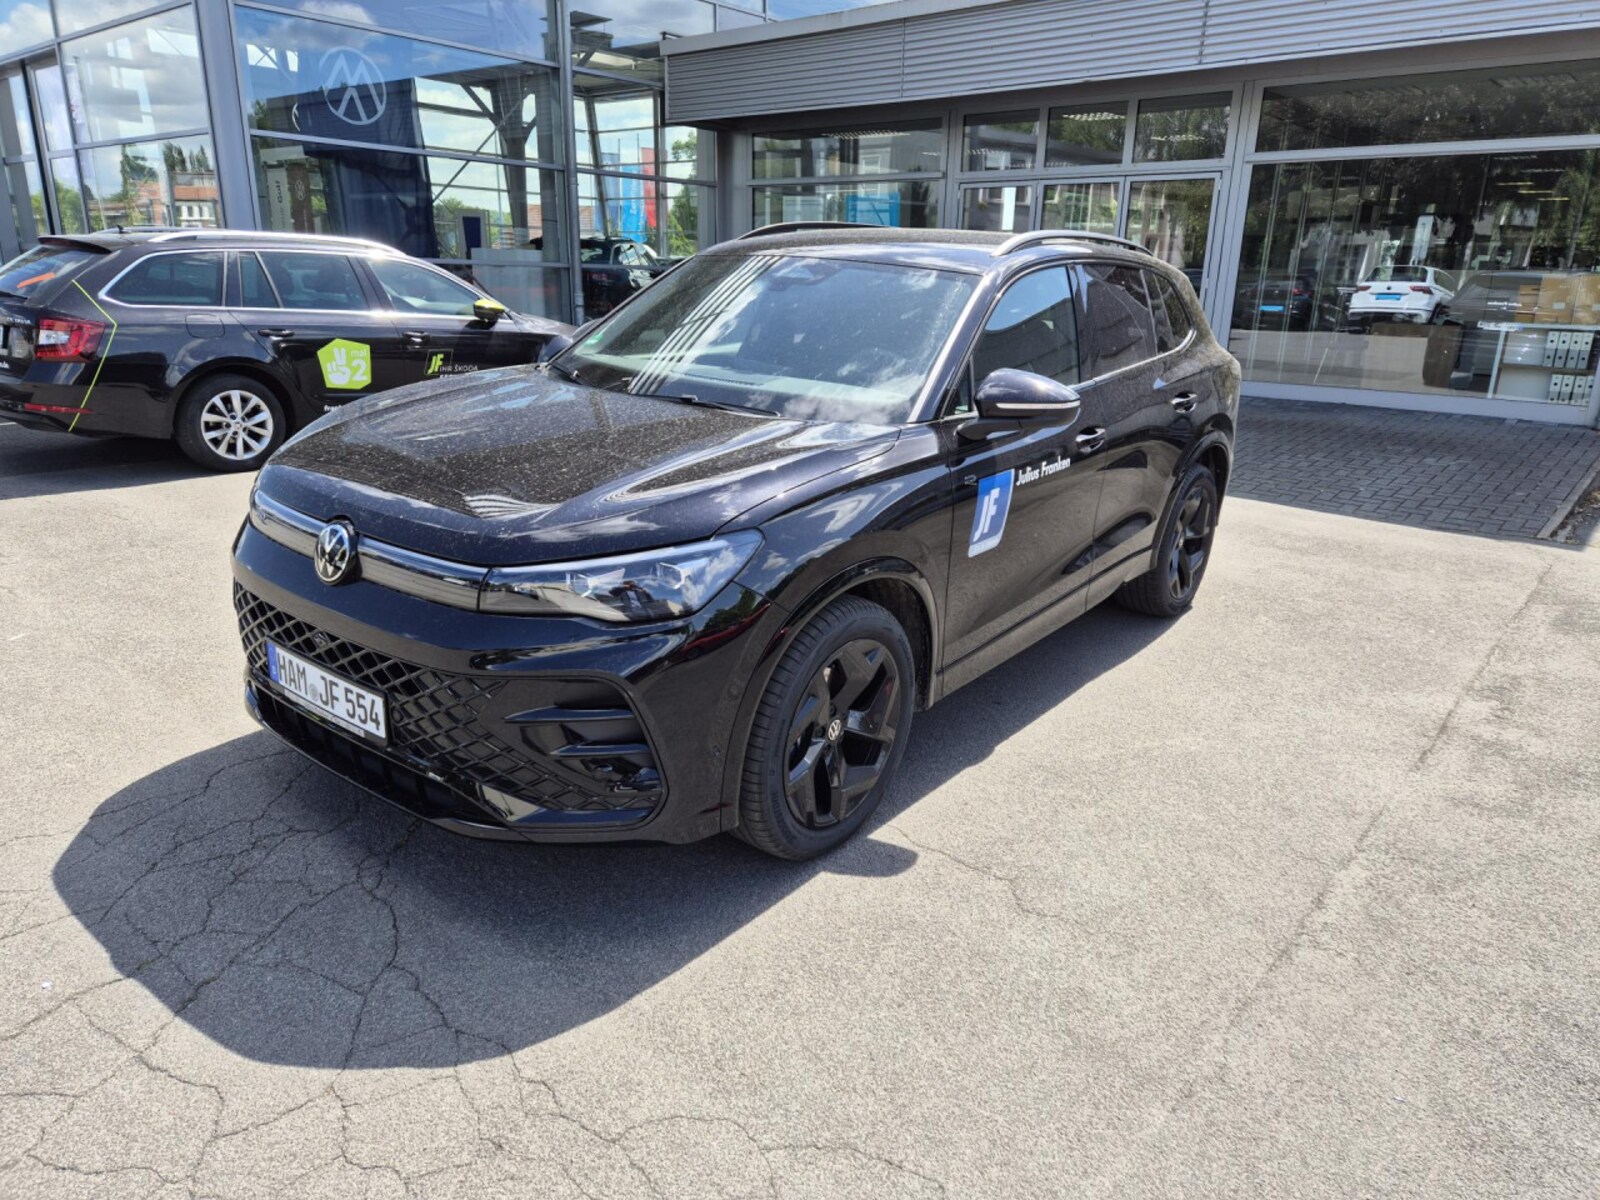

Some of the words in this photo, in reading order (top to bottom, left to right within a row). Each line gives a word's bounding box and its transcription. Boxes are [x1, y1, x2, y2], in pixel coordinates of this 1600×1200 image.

[353, 359, 368, 381] 2
[427, 353, 444, 374] JF
[454, 363, 479, 372] ŠKODA
[1016, 466, 1040, 486] Julius
[1041, 455, 1071, 477] Franken
[973, 487, 1000, 543] JF
[277, 652, 308, 696] HAM
[319, 675, 340, 710] JF
[344, 687, 380, 731] 554
